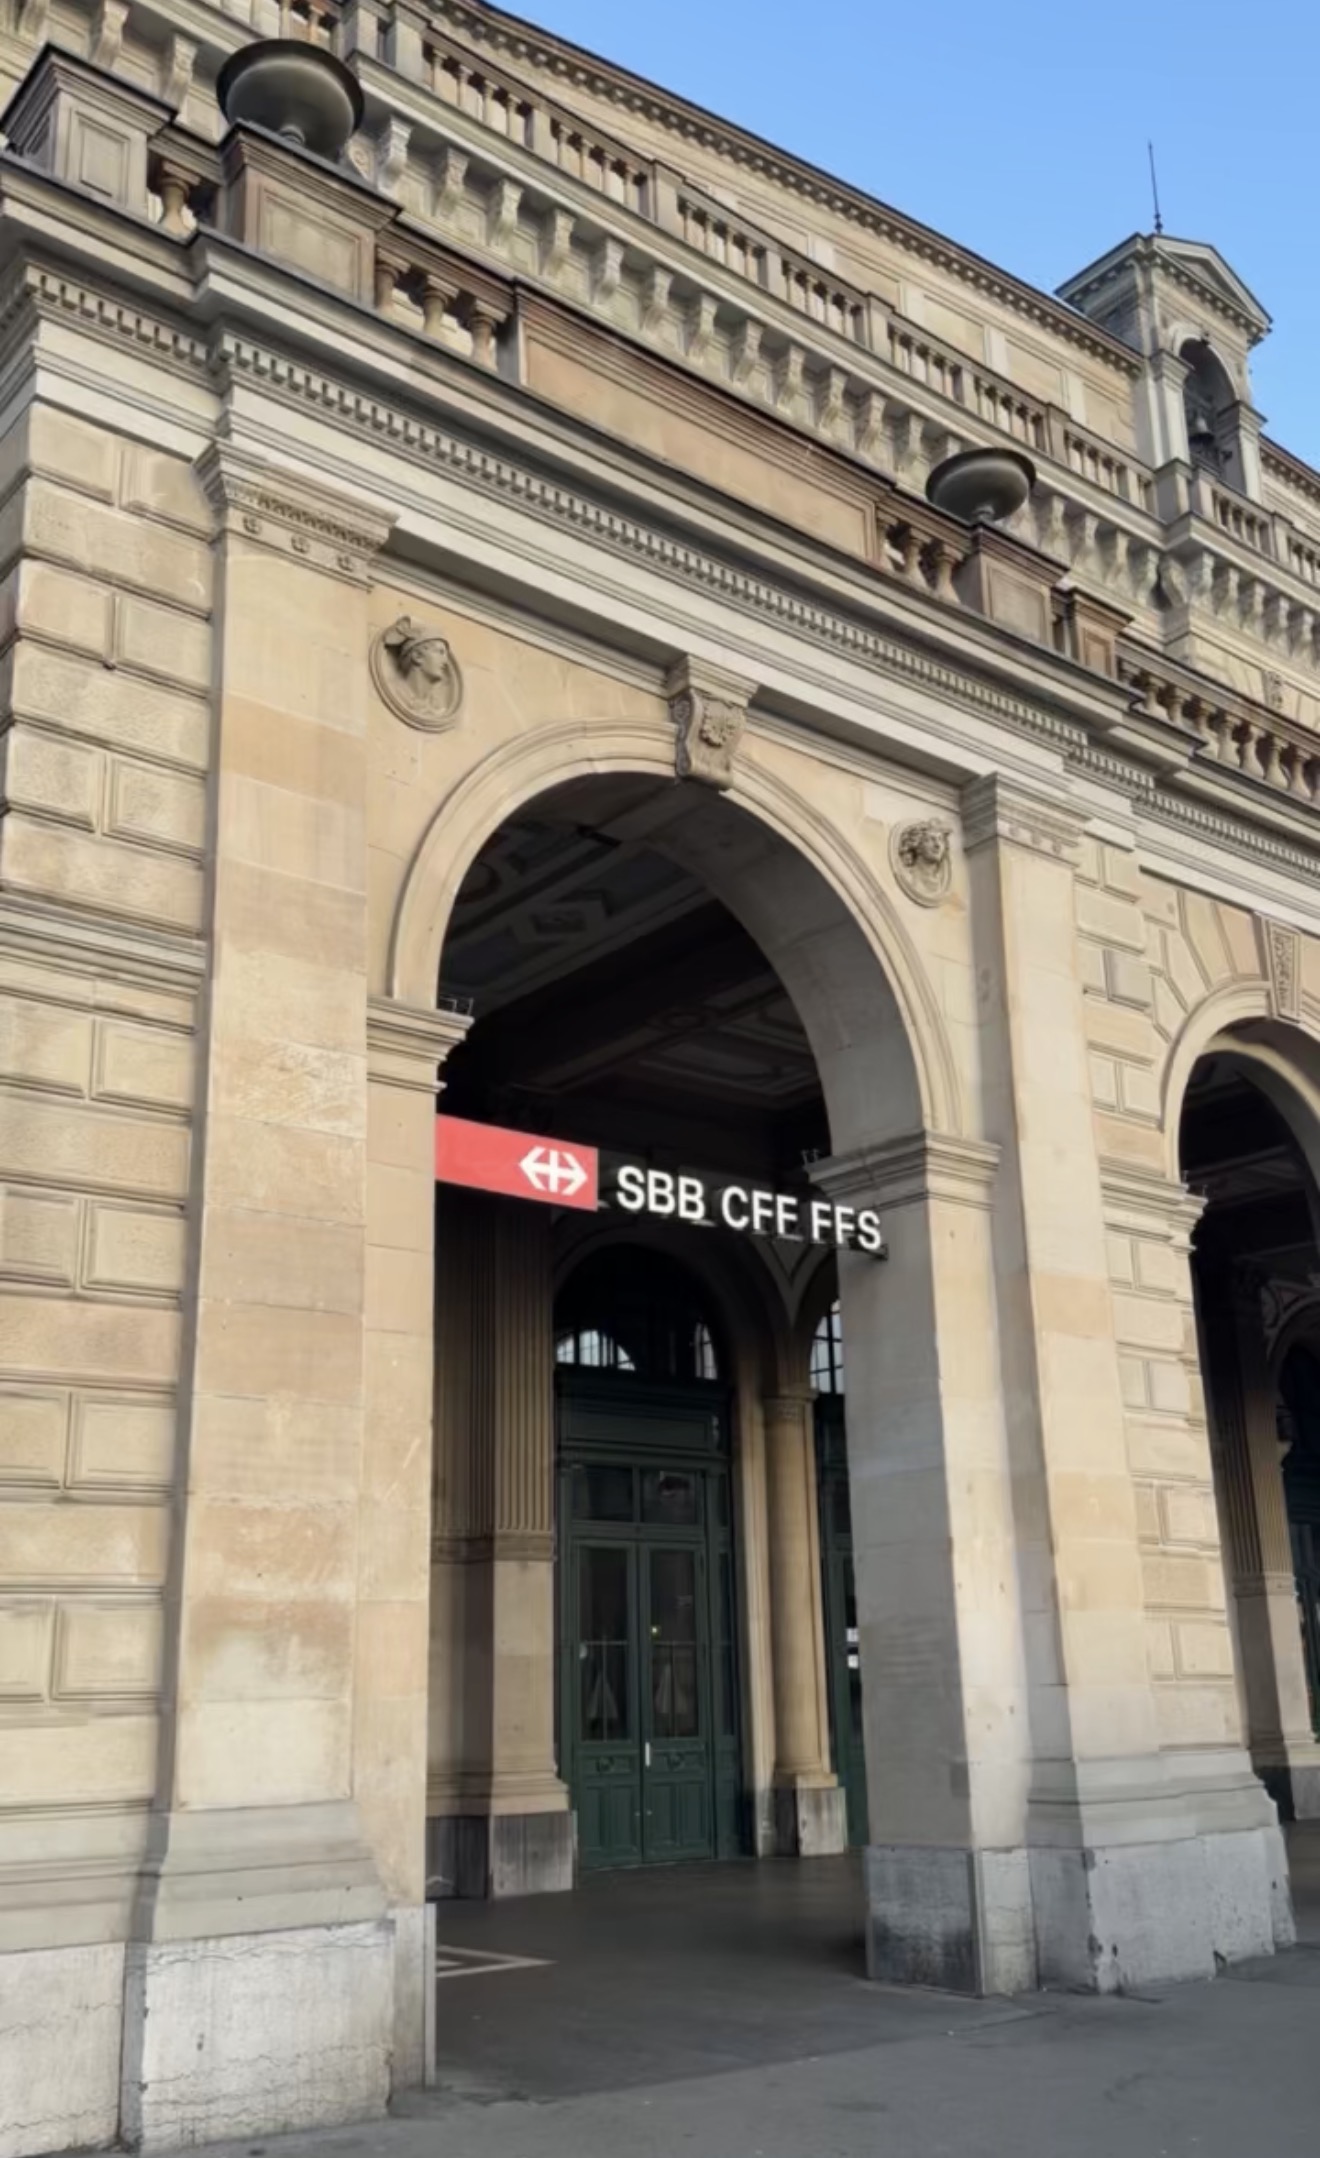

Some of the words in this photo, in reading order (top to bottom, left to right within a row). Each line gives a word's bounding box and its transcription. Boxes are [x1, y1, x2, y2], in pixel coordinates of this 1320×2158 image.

[616, 1166, 705, 1220] SBB
[721, 1186, 798, 1235] CFF
[811, 1201, 882, 1250] FFS
